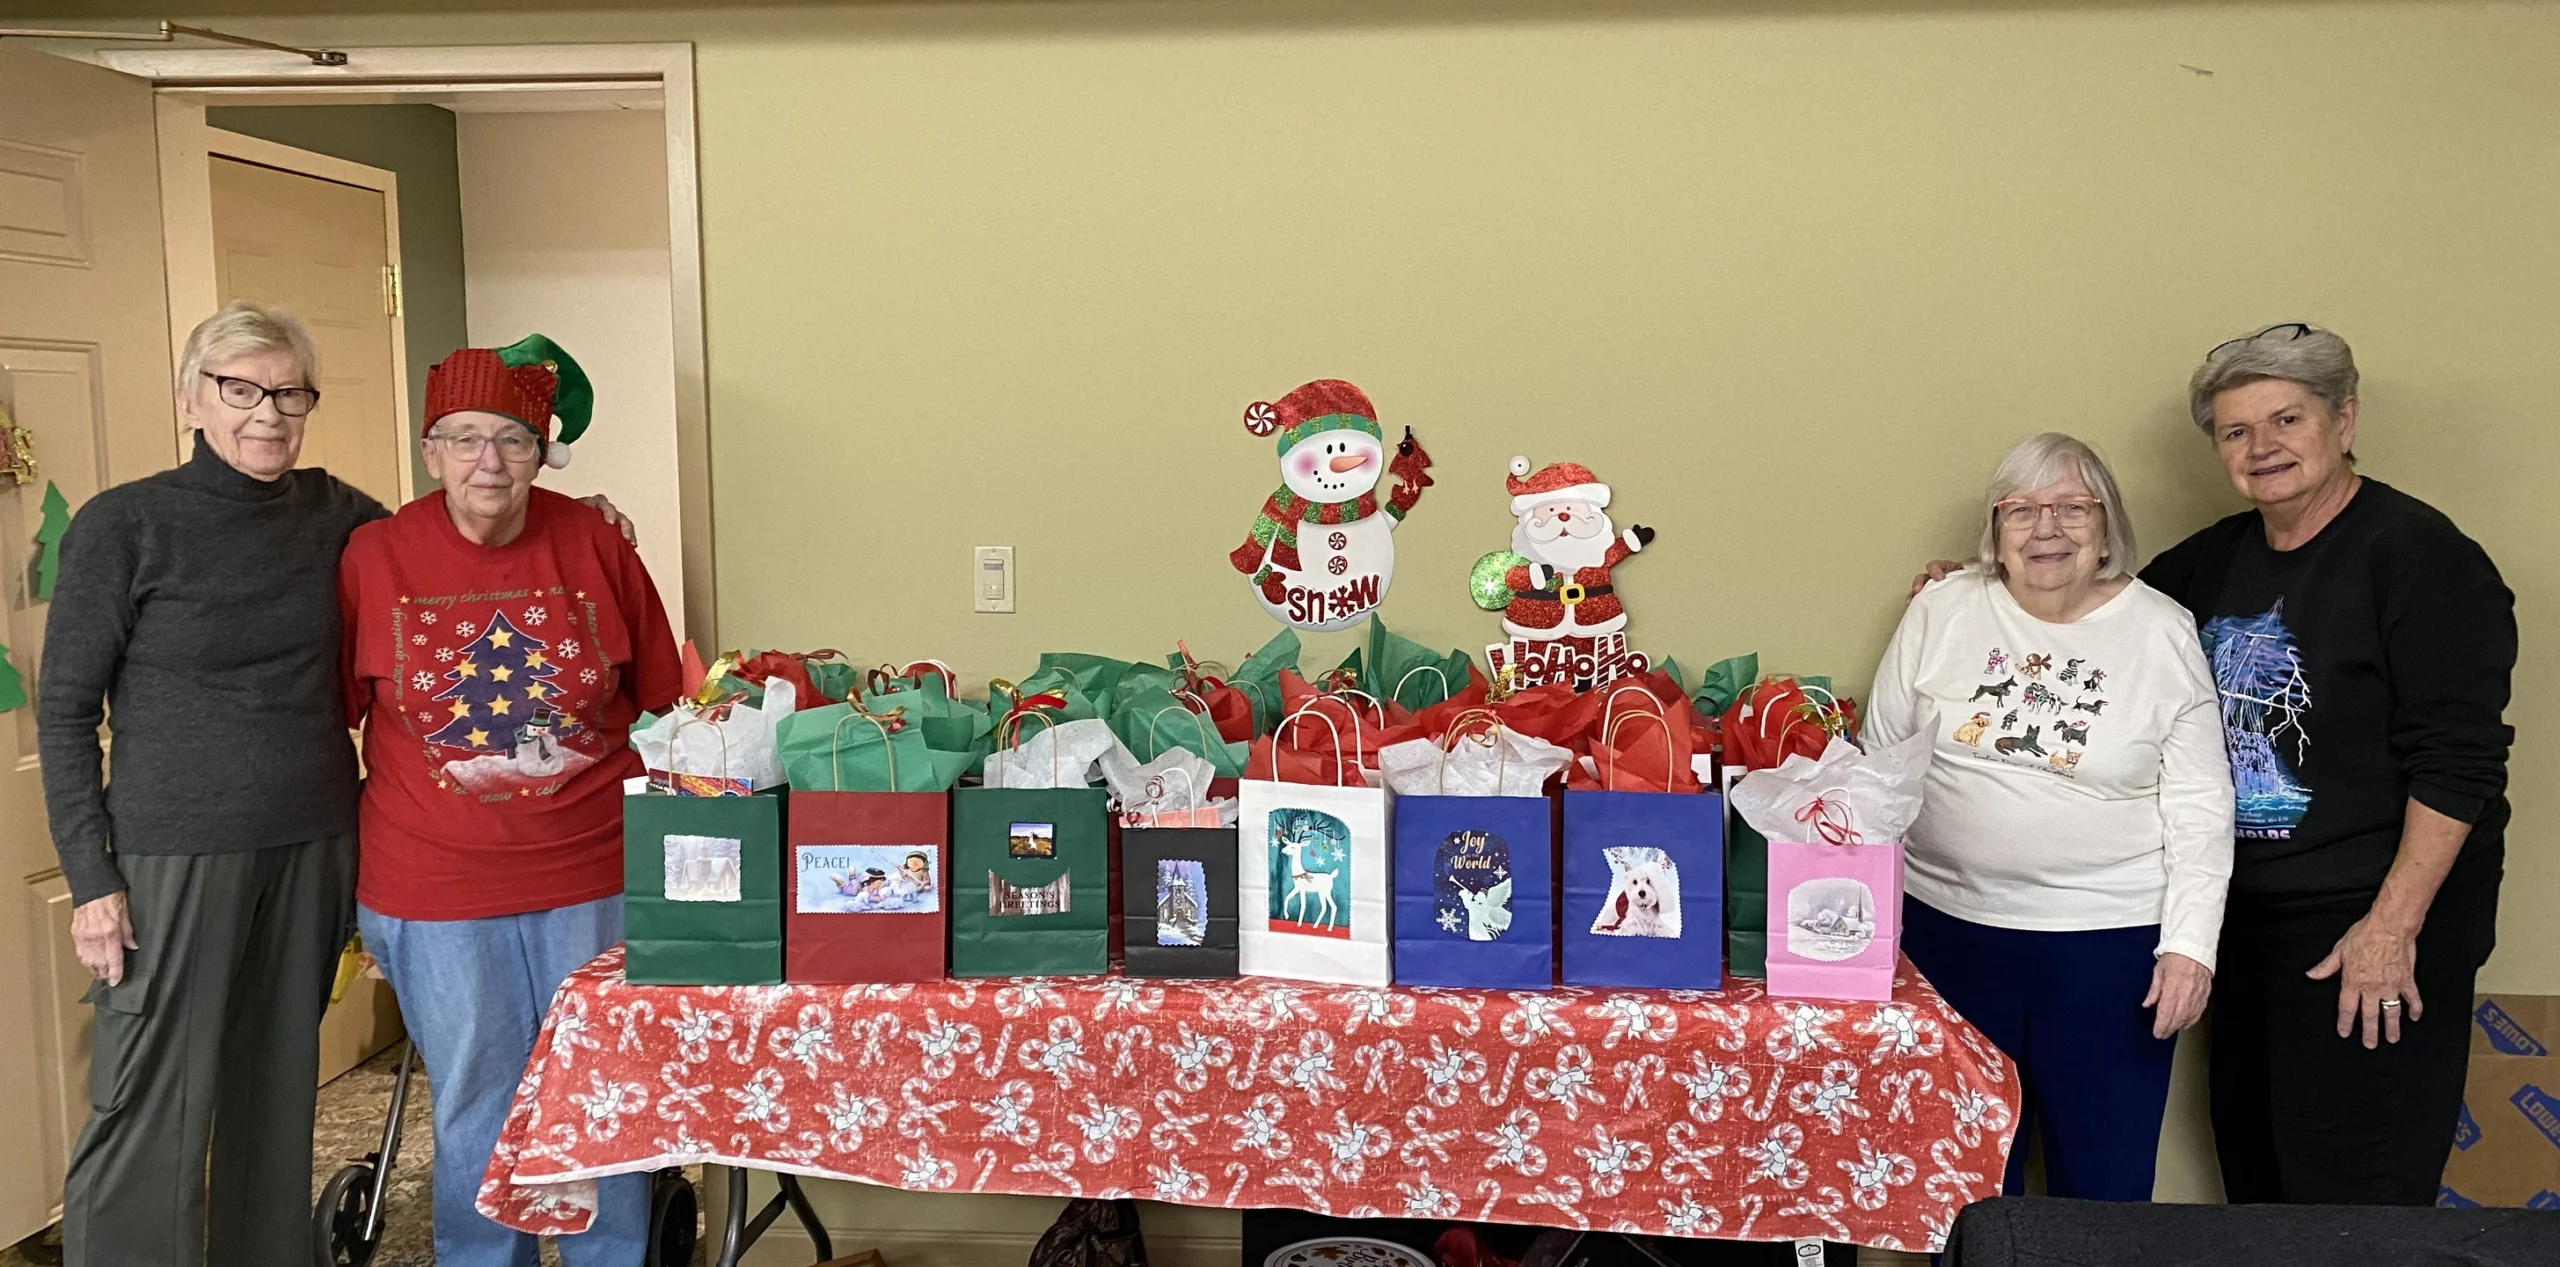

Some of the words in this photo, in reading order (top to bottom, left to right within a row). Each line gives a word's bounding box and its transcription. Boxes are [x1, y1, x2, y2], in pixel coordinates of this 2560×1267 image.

[413, 594, 456, 611] merry
[460, 588, 529, 603] christmas
[1460, 831, 1485, 854] Joy
[1451, 855, 1491, 870] World
[1003, 891, 1055, 900] SEASON'S
[1000, 900, 1060, 909] GREETINGS
